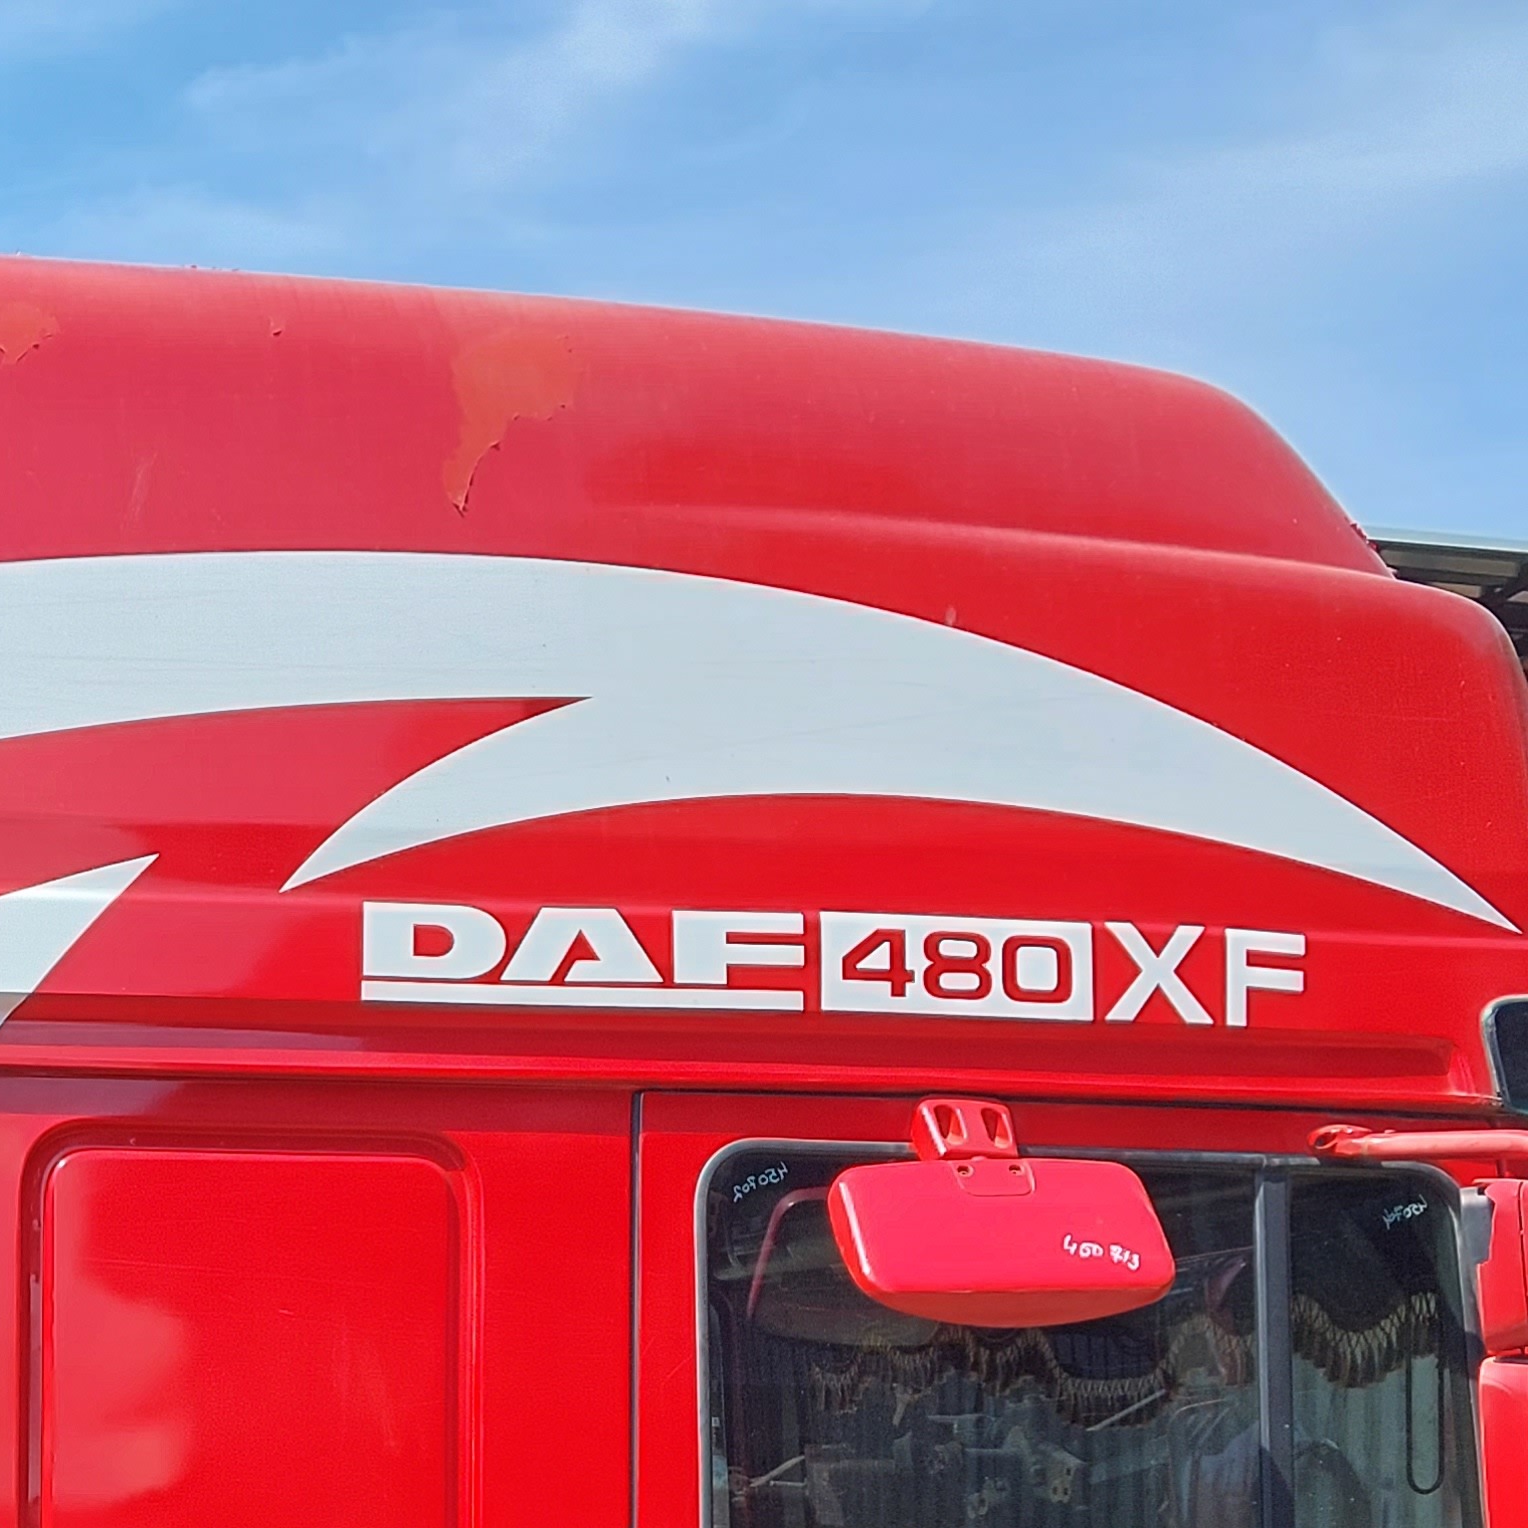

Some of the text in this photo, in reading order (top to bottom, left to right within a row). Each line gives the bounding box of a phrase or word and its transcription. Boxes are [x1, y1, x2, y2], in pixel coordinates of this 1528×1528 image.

[362, 901, 1306, 1027] DAF 480 XF
